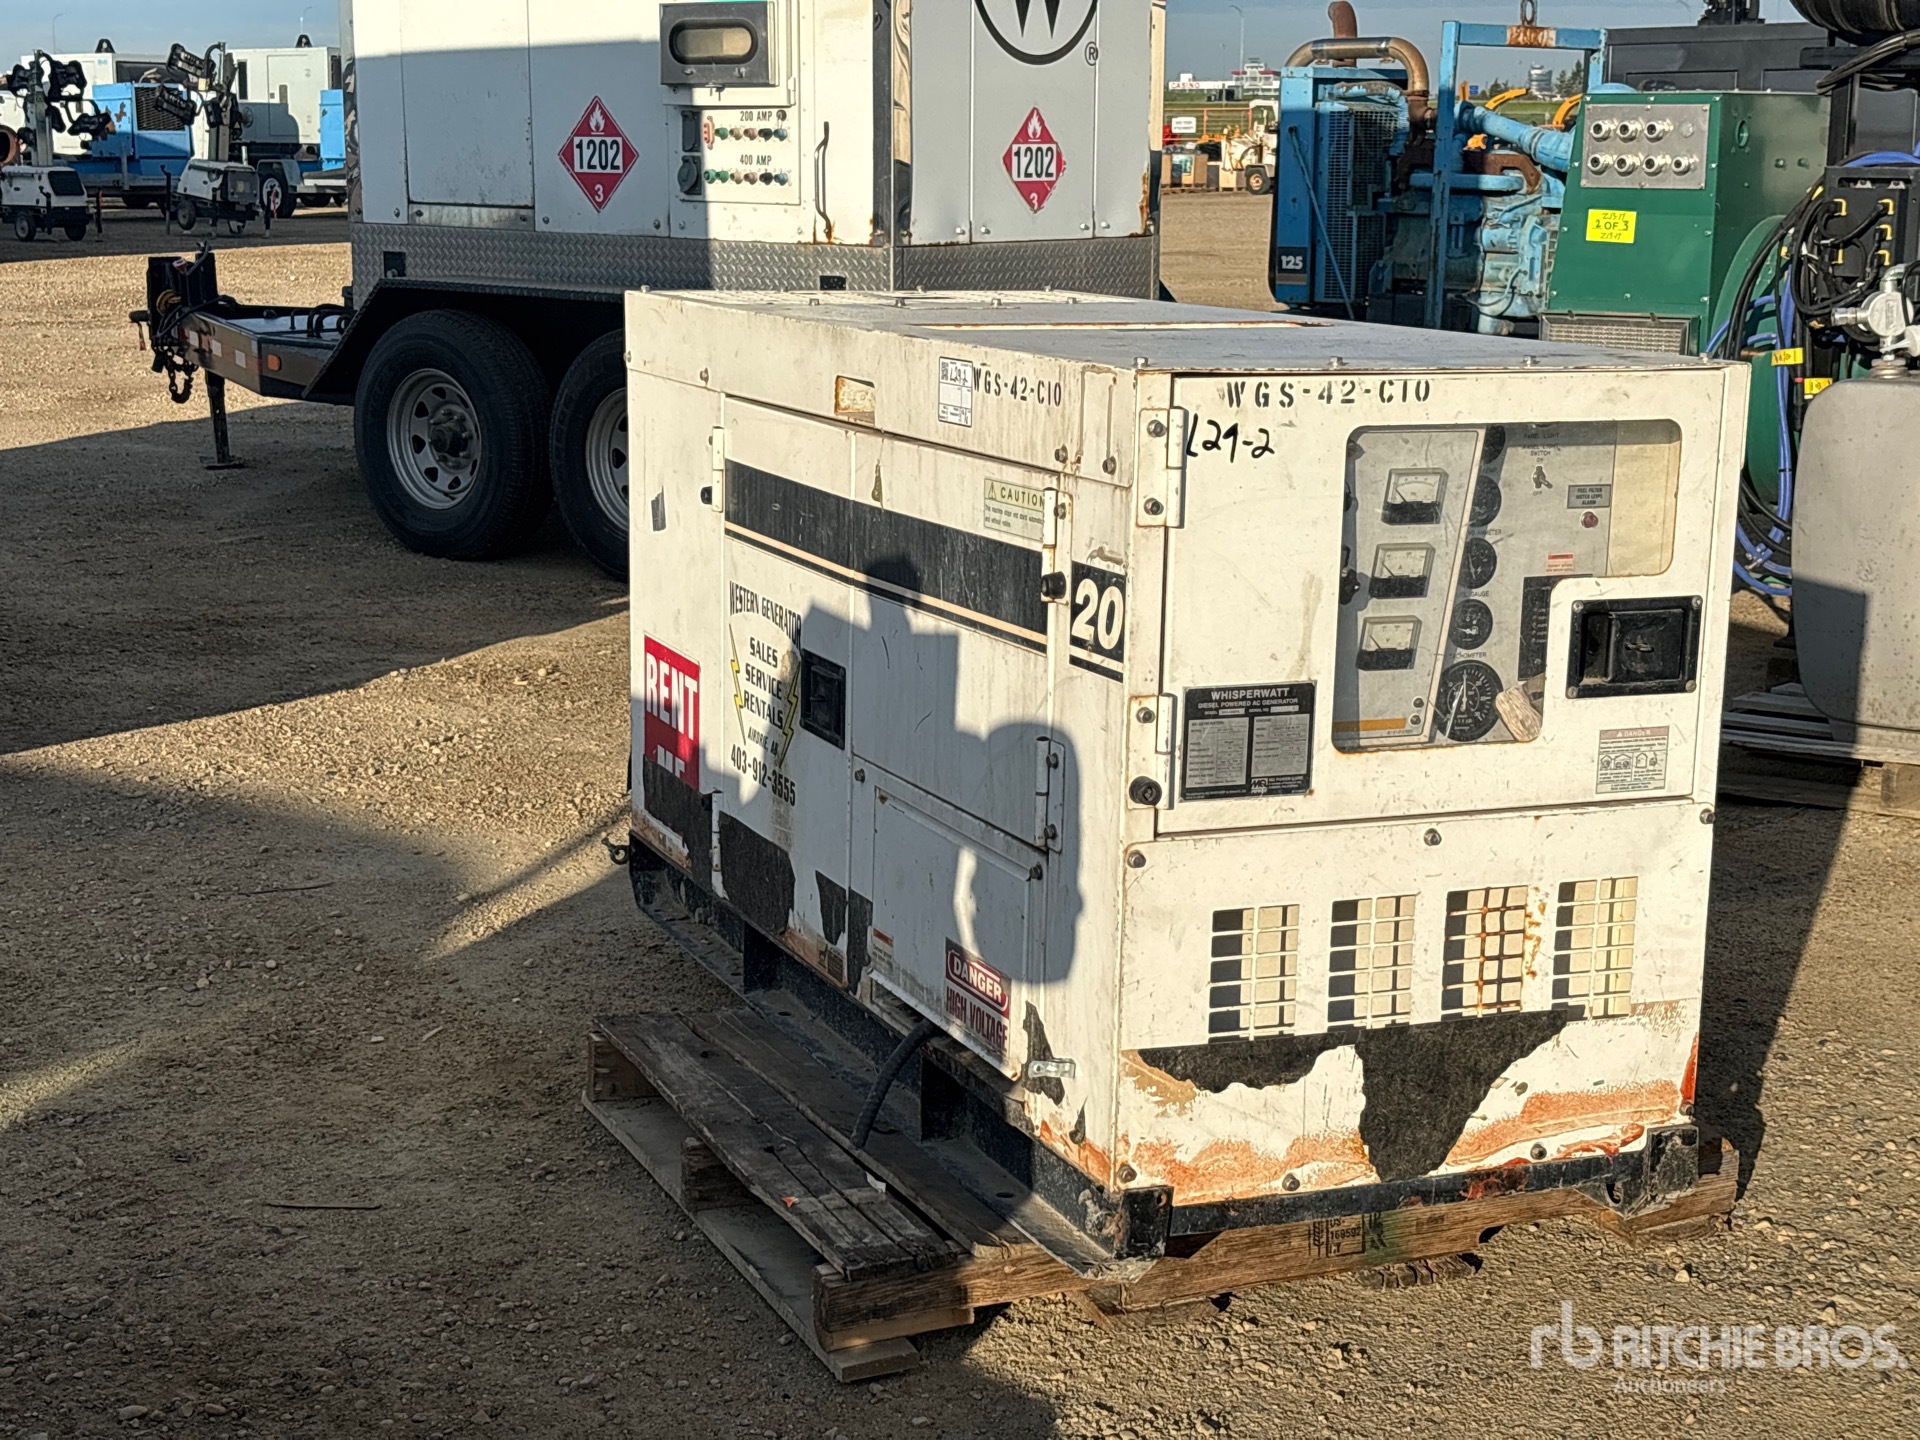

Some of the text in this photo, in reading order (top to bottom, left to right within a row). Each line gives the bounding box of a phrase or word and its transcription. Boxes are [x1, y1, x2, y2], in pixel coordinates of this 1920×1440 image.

[740, 110, 772, 121] 200 AMP
[576, 139, 620, 170] 1202
[740, 154, 772, 166] 400 AMP
[1013, 146, 1054, 178] 1202
[594, 184, 603, 202] 3
[1029, 192, 1039, 210] 3
[1595, 219, 1629, 231] 2 OF 3
[1281, 255, 1303, 270] 125
[1001, 487, 1044, 508] CAUTION
[730, 580, 802, 651] WESTERN GENERATOR
[1071, 578, 1124, 650] 20
[750, 636, 778, 668] SALES
[646, 652, 697, 741] RENT
[745, 663, 782, 700] SERVICE
[1211, 688, 1290, 700] WHISPERWATT
[744, 690, 783, 730] RENTALS
[731, 744, 796, 807] 403-912-3555
[954, 955, 1002, 1004] DANGER
[946, 985, 1008, 1053] HIGH VOLTAGE
